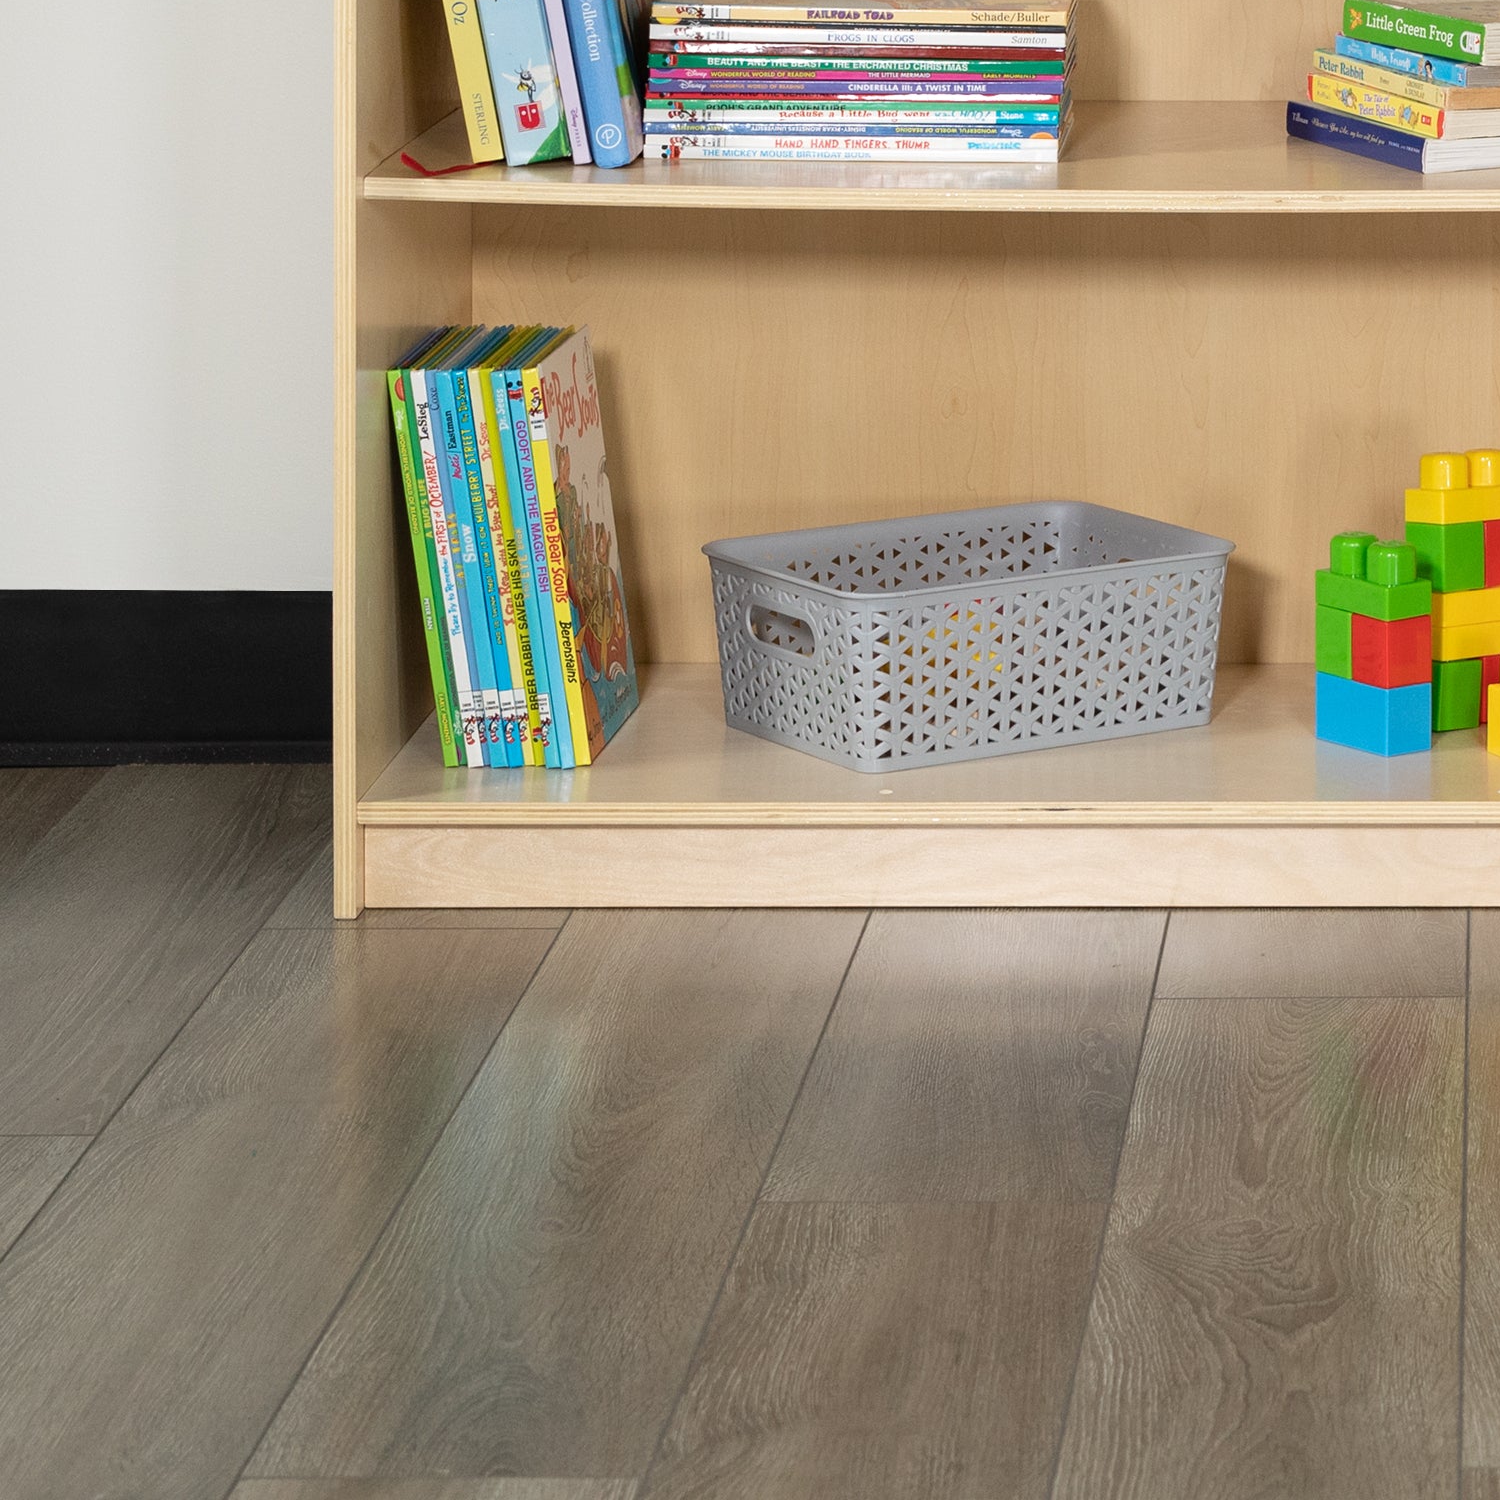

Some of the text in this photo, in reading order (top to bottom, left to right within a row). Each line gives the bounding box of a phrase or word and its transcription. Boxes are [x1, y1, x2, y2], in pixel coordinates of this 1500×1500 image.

[452, 0, 467, 25] Oz
[807, 10, 1050, 22] RAILROAD TOAD Schade/Buller
[828, 34, 861, 42] FROGS
[883, 35, 915, 43] CLOGS
[1011, 36, 1047, 45] Samton
[1366, 12, 1454, 48] Little Green Frog
[708, 58, 822, 68] BEAUTY AND THE BEAST
[832, 60, 968, 71] THE ENCHANTED CHRISTMAS
[1319, 57, 1364, 81] Peter Rabbit
[848, 84, 898, 92] CINDERELLA
[472, 93, 490, 145] STERLING
[1359, 103, 1395, 119] Peter Rabbit
[702, 149, 720, 157] THE
[759, 150, 794, 158] MOUSE
[430, 387, 439, 411] Coxe
[496, 389, 509, 431] Dr. Seuss
[417, 402, 429, 441] LeSieg
[445, 410, 457, 449] Eastman
[480, 422, 489, 446] Seuss
[418, 479, 433, 538] A BUG'S LIFE
[516, 420, 550, 593] GOOFY AND THE MAGIC FISH
[462, 524, 476, 563] Snow
[506, 539, 519, 567] SKIN
[543, 508, 568, 603] The Bear Scouts
[511, 570, 522, 590] HIS
[514, 592, 528, 630] SAVES
[520, 634, 535, 677] RABBIT
[559, 620, 577, 684] Berenstains
[527, 678, 539, 710] BRER
